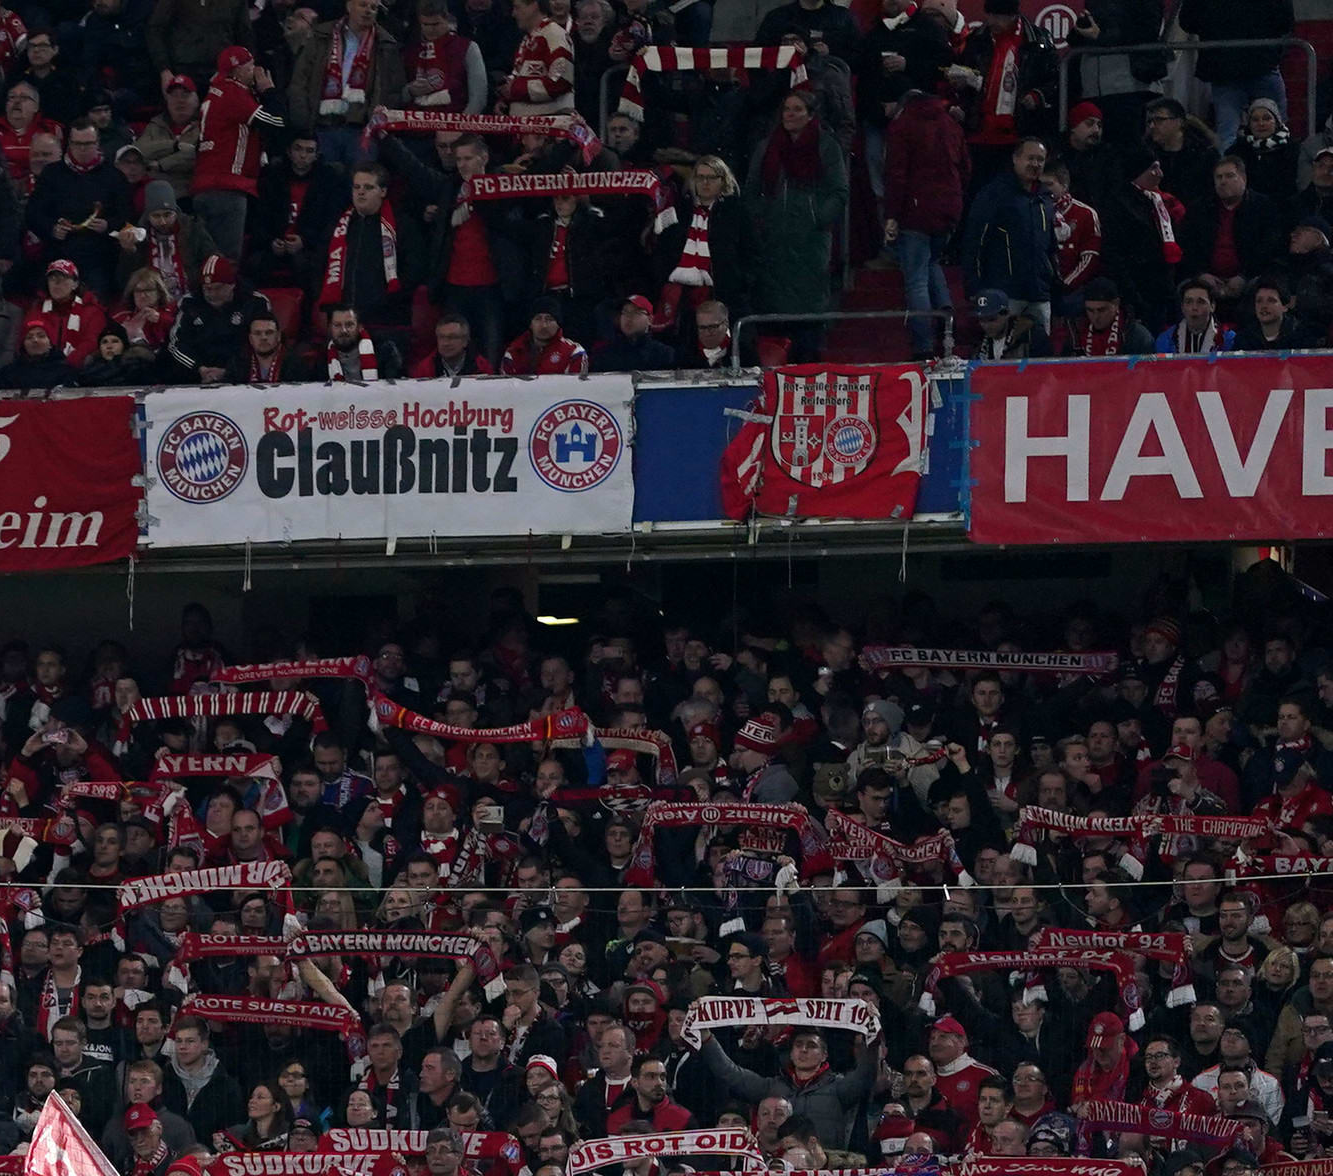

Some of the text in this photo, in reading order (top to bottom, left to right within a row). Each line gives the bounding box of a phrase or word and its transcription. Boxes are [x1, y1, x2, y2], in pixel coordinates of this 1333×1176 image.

[474, 170, 656, 195] FC BAYERN MÜNCHEN
[403, 401, 514, 433] Hochburg
[536, 402, 616, 441] FC BAYERN
[163, 413, 242, 455] FC BAYERN
[256, 425, 518, 498] Claußnitz
[891, 650, 1081, 667] FC BAYERN MÜNCHEN
[308, 931, 382, 953] BAYERN
[385, 931, 480, 956] MÜNCHEN
[1050, 932, 1127, 948] Neuhof
[195, 998, 244, 1013] ROTE
[806, 1001, 846, 1021] SEIT
[626, 1136, 686, 1156] ROT
